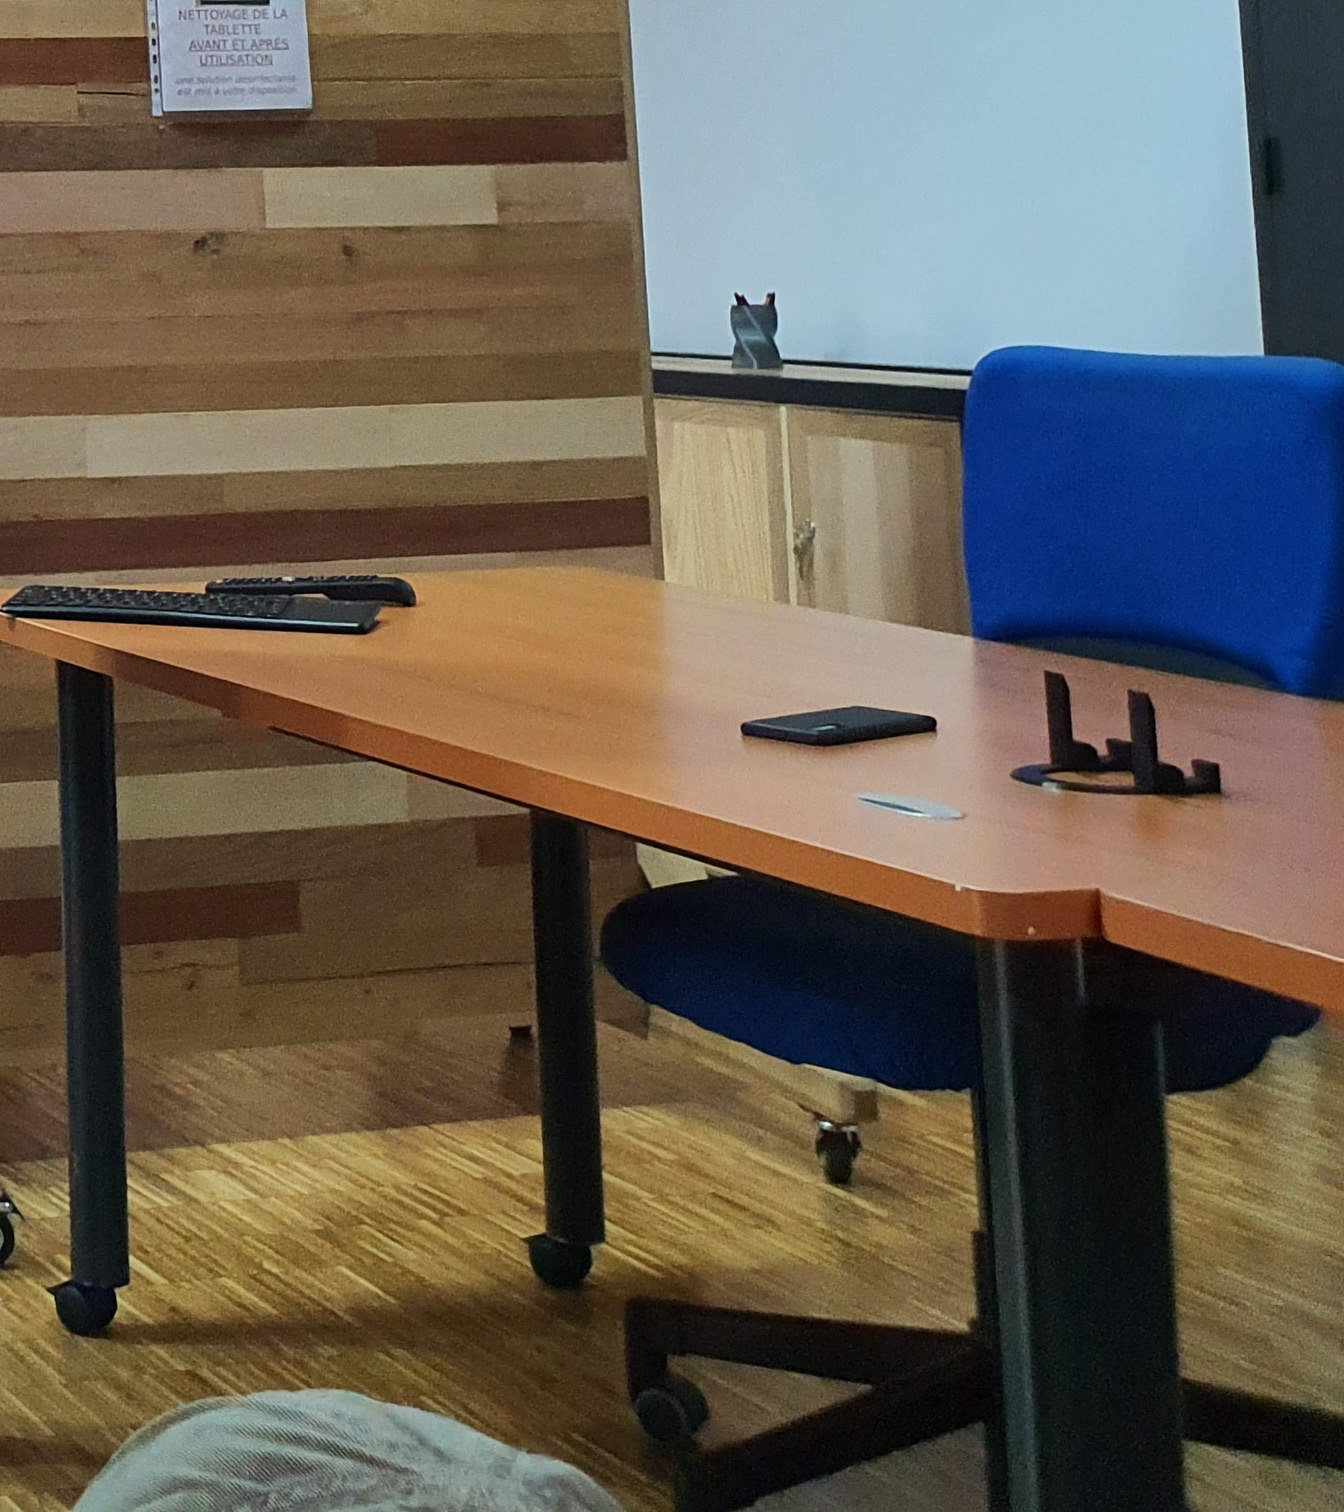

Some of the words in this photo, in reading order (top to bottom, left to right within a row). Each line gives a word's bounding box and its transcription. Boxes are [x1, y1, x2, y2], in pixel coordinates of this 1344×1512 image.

[178, 9, 248, 20] NETTOYAGE
[252, 9, 269, 20] DE
[273, 9, 289, 20] LA
[204, 24, 261, 35] TABLETTE
[189, 39, 228, 51] AVANT
[232, 39, 246, 51] ET
[199, 53, 273, 66] UTILISATION
